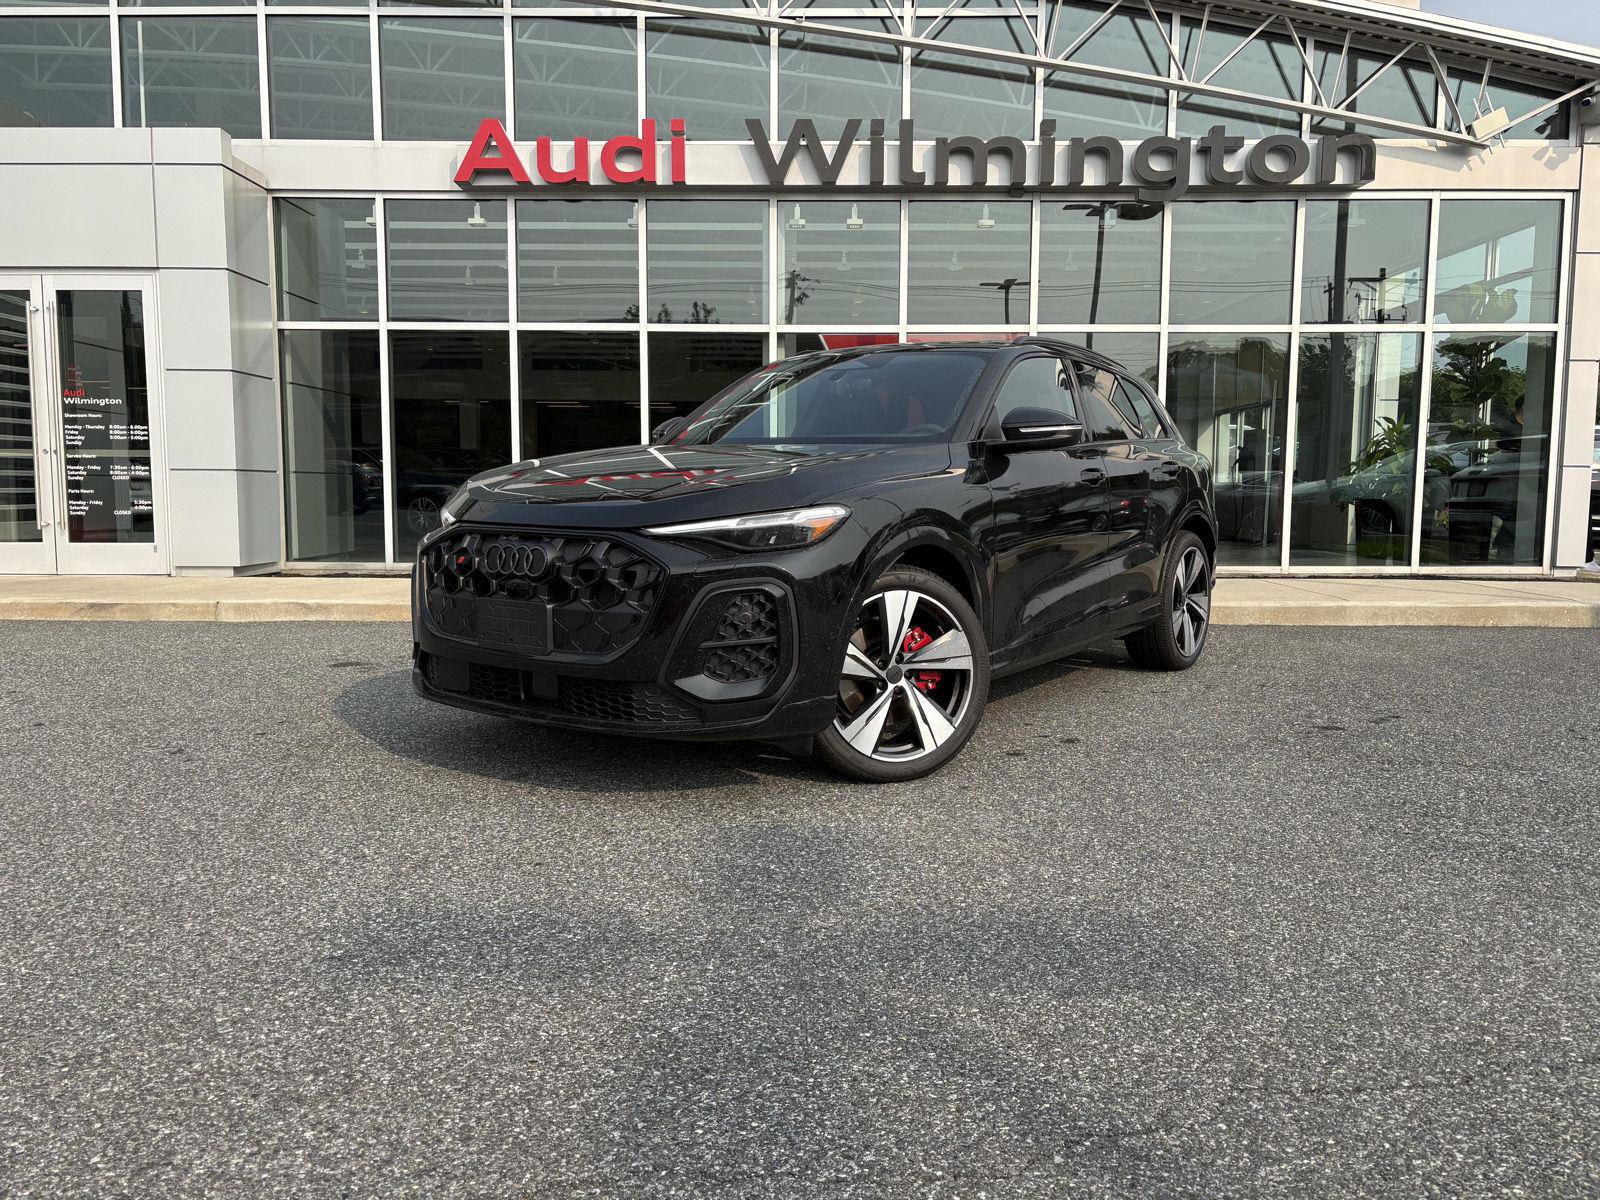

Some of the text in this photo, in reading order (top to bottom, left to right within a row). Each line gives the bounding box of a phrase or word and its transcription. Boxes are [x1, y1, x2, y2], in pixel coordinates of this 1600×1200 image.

[453, 118, 1376, 201] Audi Wilmington
[63, 388, 85, 397] Audi
[63, 397, 122, 406] Wilmington
